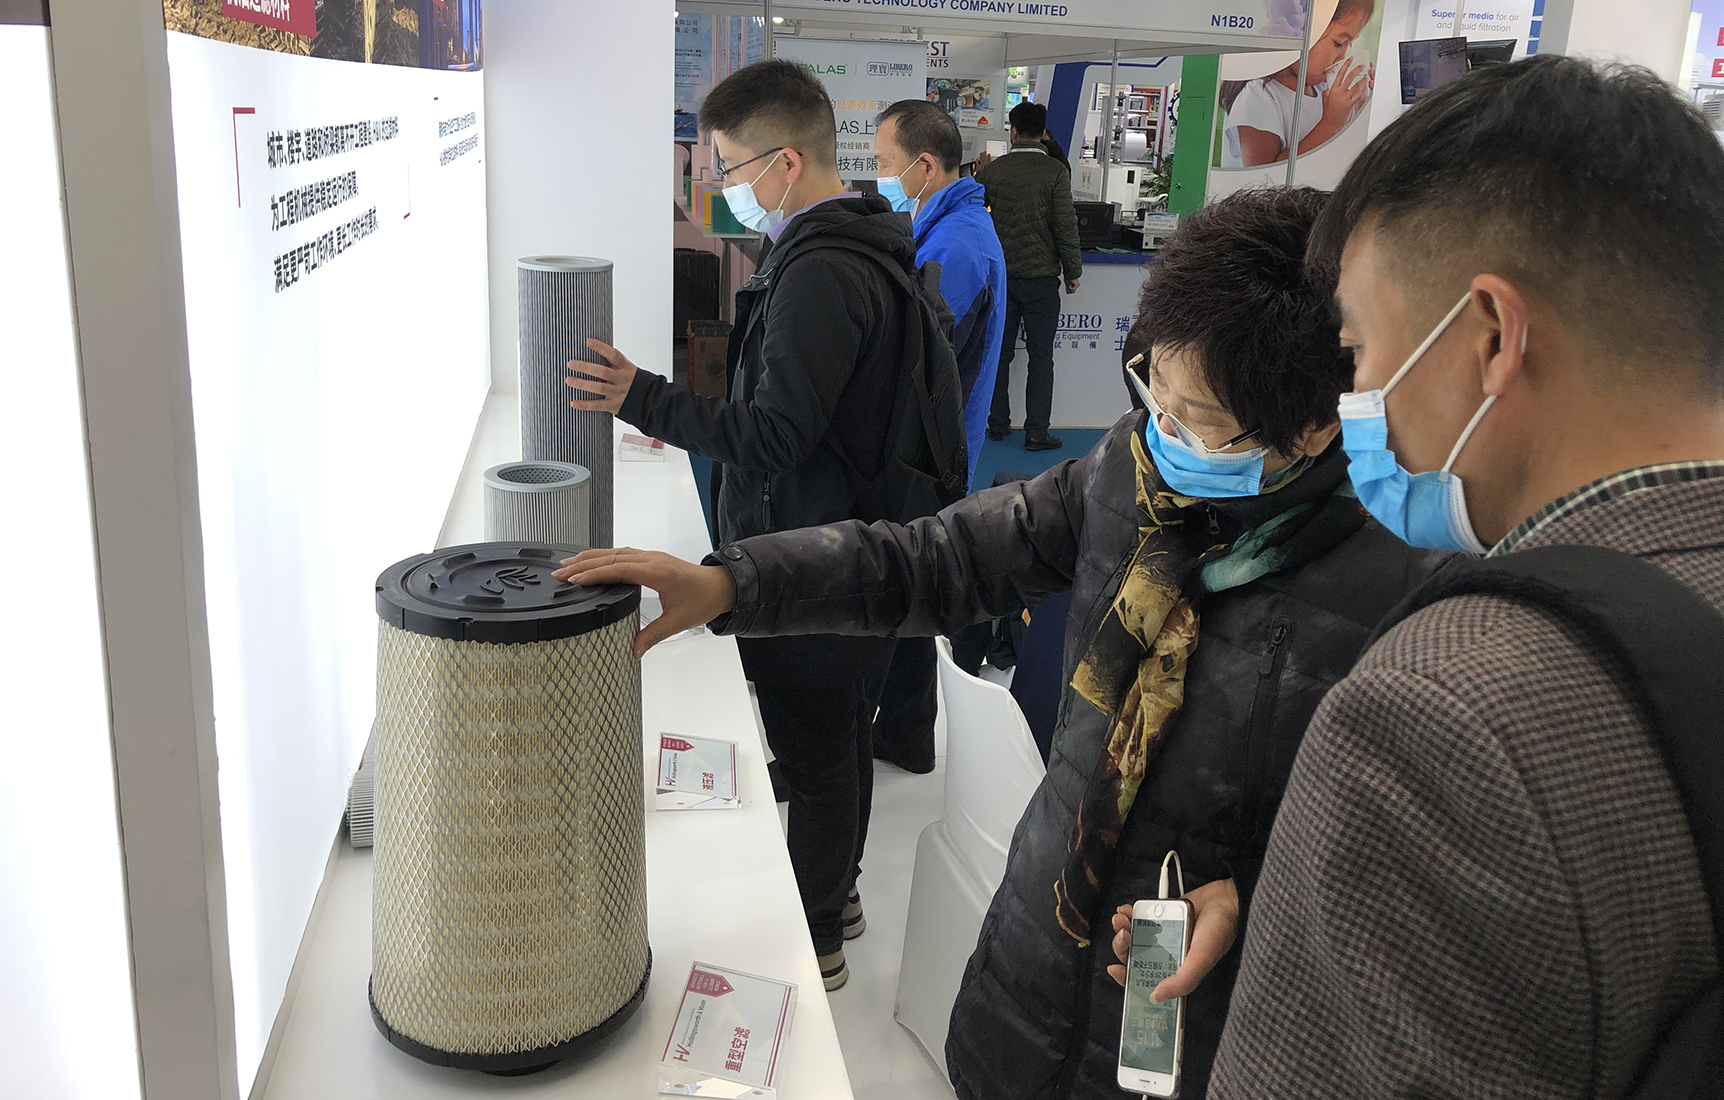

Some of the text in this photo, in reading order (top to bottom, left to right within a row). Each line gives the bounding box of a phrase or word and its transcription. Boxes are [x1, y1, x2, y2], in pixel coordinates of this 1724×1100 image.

[950, 0, 1012, 14] COMPANY
[1018, 5, 1068, 17] LIMITED
[1431, 9, 1519, 21] Superr media for air
[1211, 14, 1254, 29] N1B20
[1437, 21, 1453, 29] and
[1479, 24, 1511, 32] filtration
[1057, 314, 1102, 328] BERO
[1062, 332, 1100, 340] Equipment
[725, 1026, 750, 1073] 重型空滤
